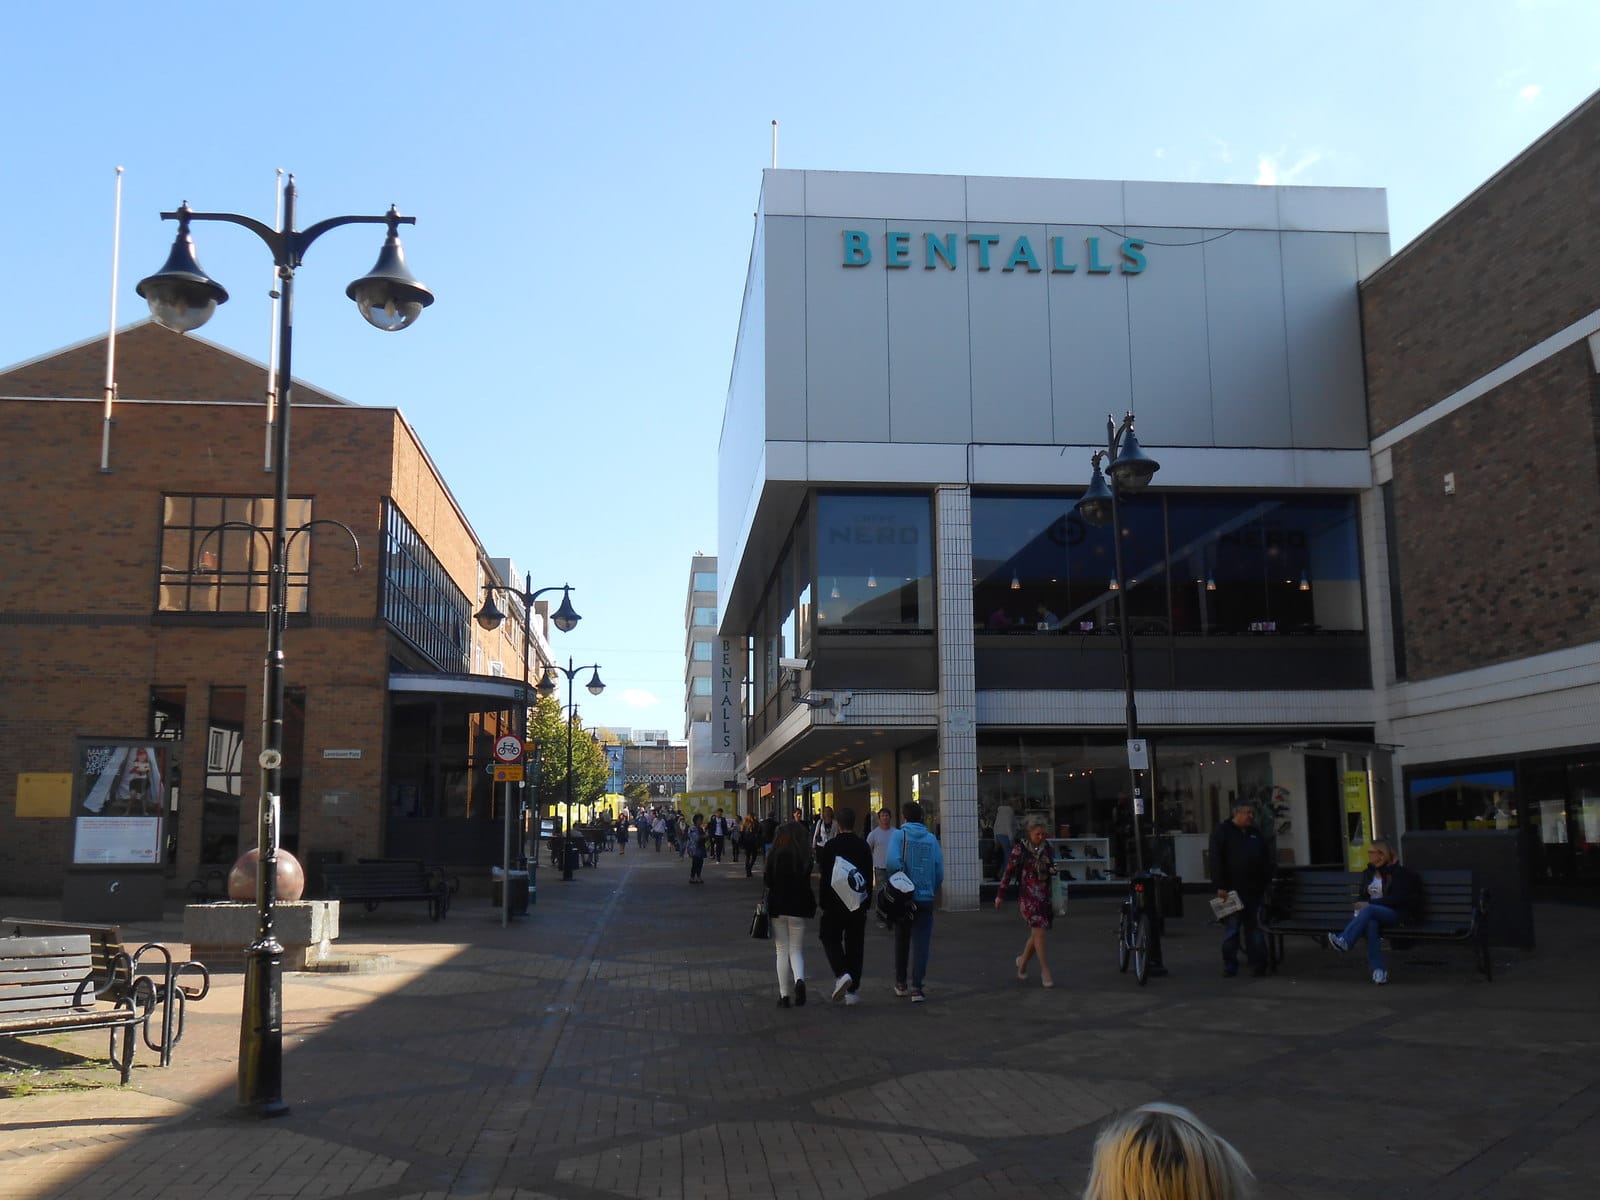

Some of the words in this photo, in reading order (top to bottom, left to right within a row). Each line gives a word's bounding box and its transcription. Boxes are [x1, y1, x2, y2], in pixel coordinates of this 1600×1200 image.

[842, 229, 1147, 276] BENTALLS
[829, 526, 919, 545] NERO
[720, 639, 732, 747] BENTALLS
[1134, 787, 1141, 796] 9
